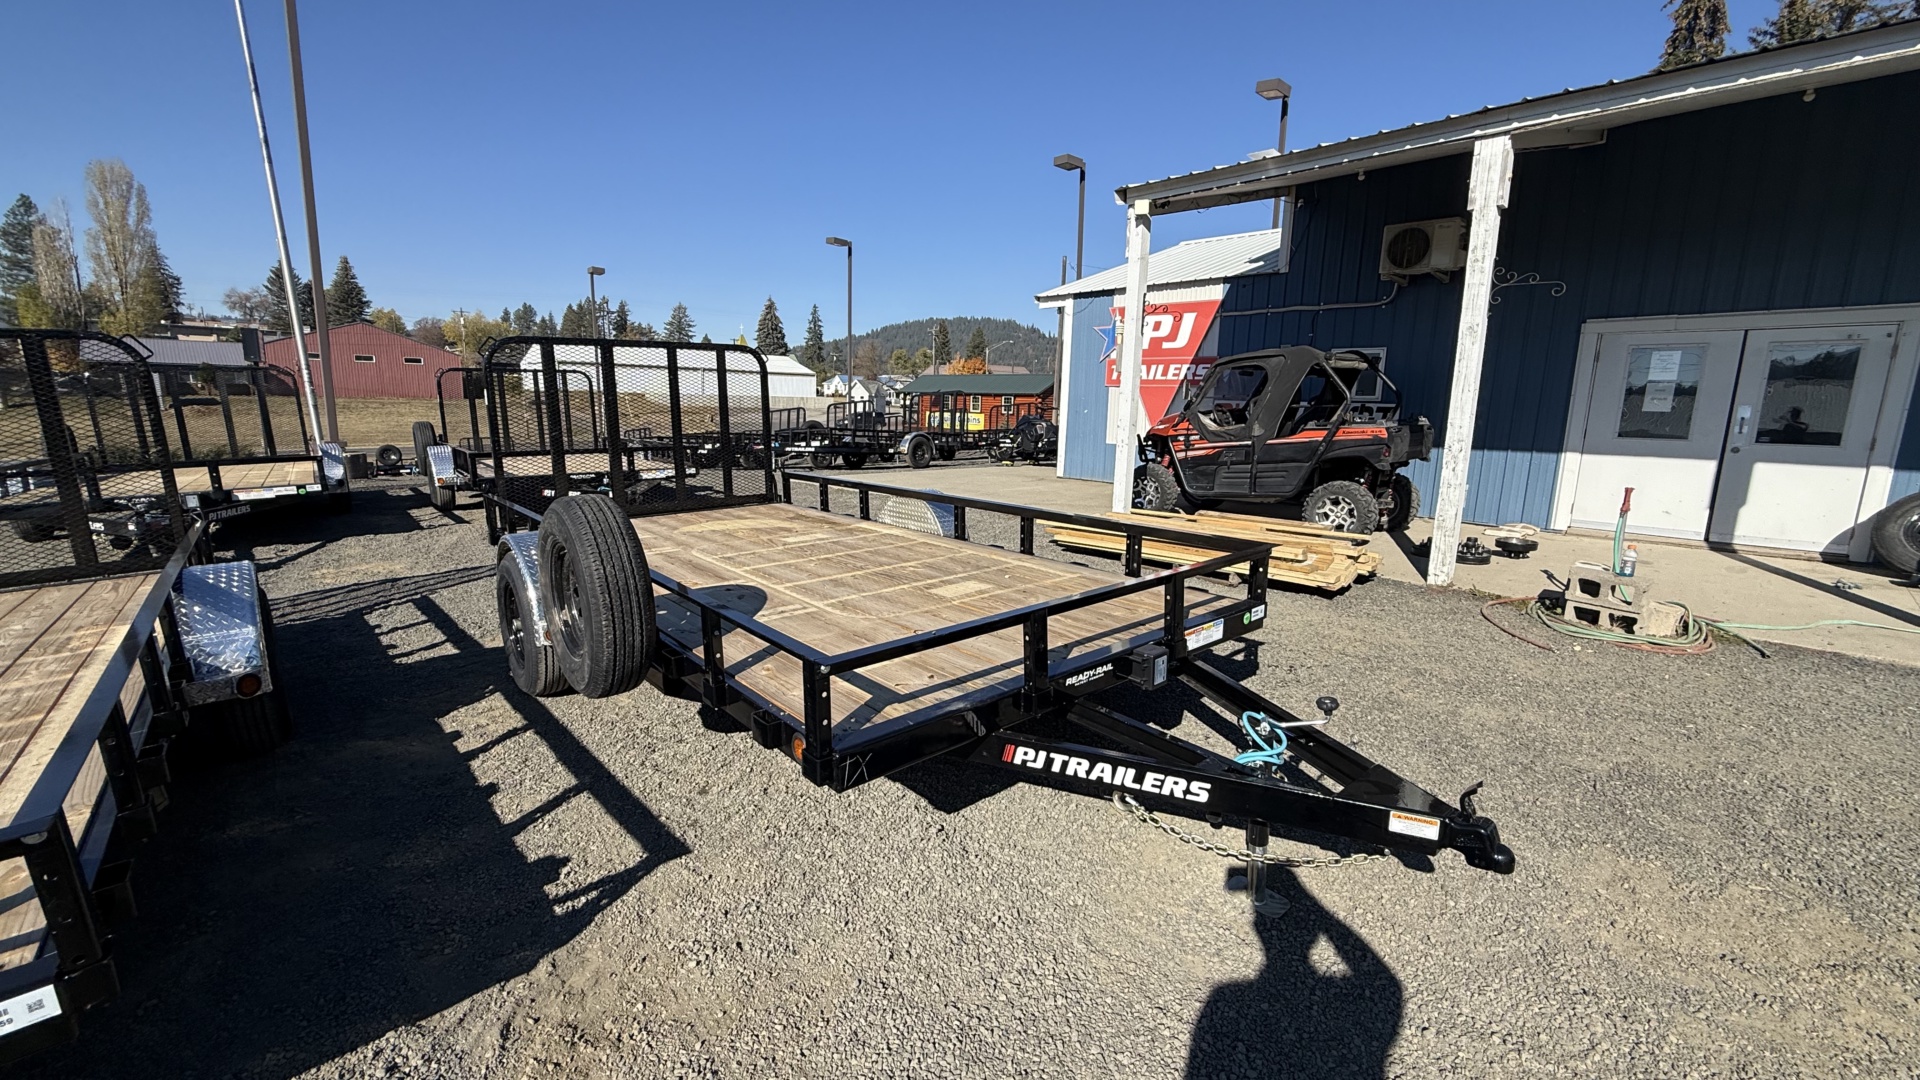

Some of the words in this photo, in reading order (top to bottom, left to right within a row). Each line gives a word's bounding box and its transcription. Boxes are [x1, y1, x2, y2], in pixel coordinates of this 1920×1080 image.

[1142, 312, 1198, 350] PJ
[1111, 363, 1211, 381] TAILERS
[217, 504, 251, 518] TRAILERS
[1065, 663, 1113, 686] READY-RAIL
[1013, 745, 1048, 770] PJ
[1049, 752, 1212, 804] TRAILERS
[1403, 815, 1434, 826] WARNING
